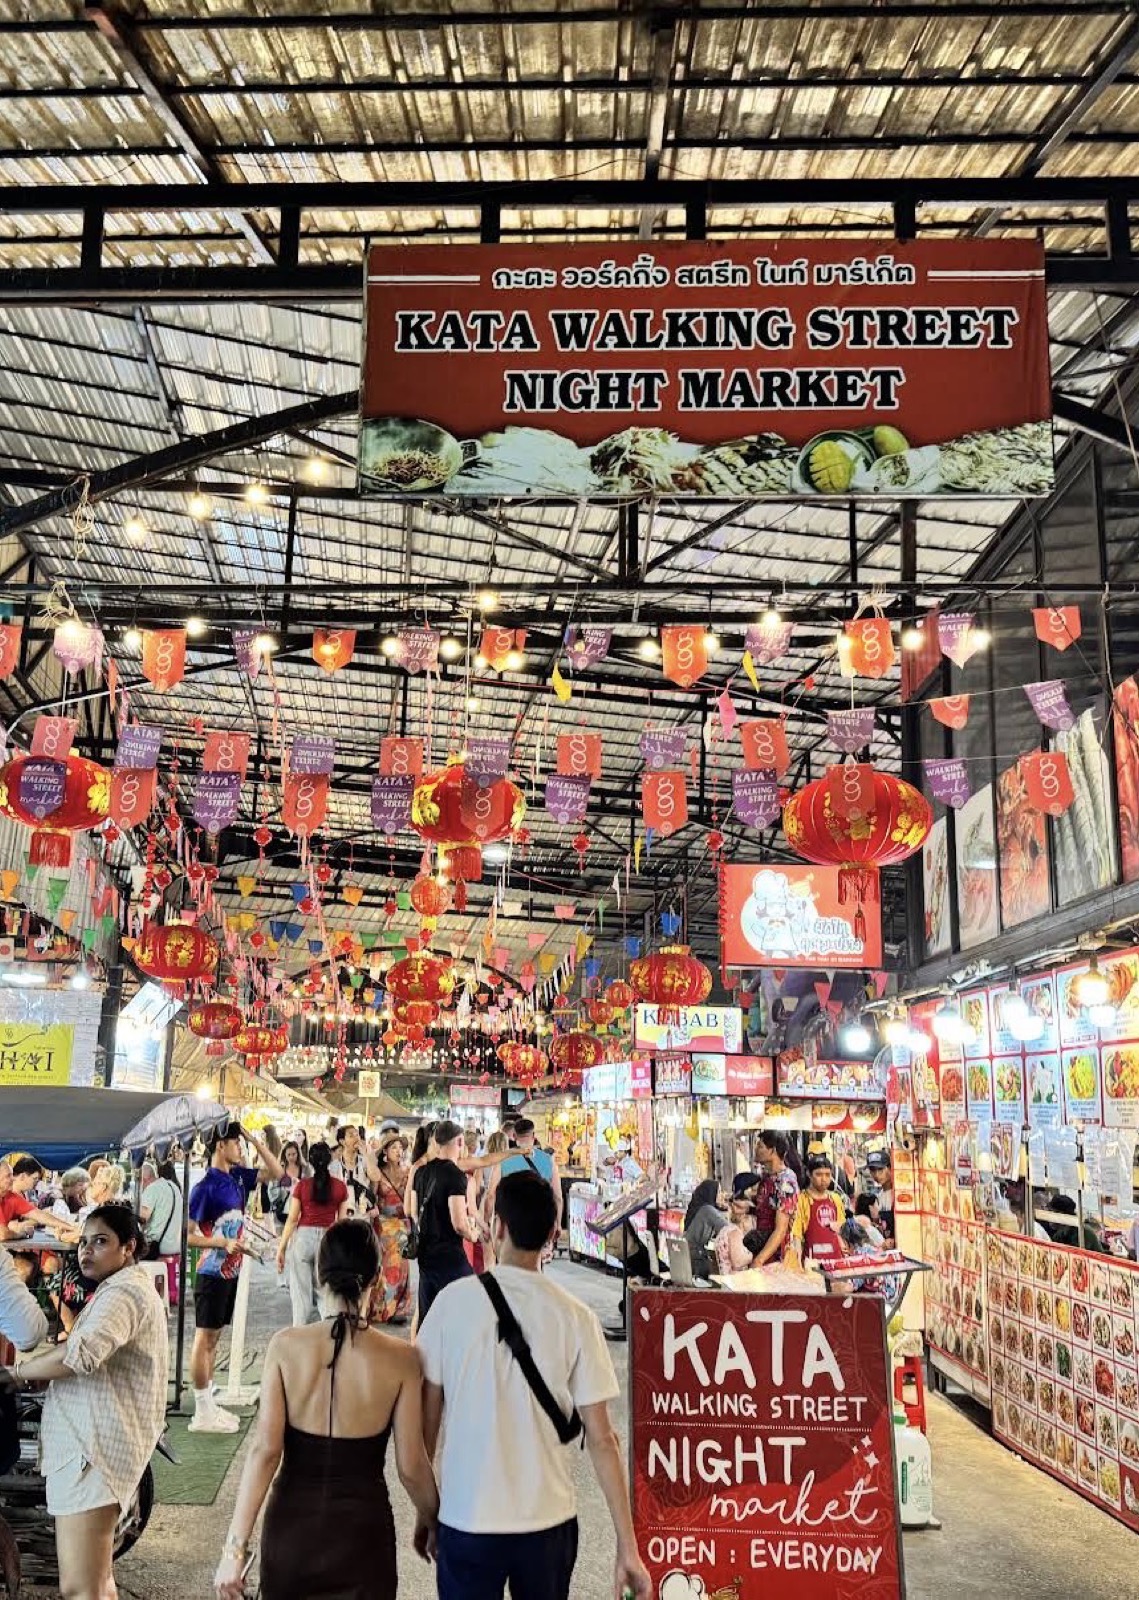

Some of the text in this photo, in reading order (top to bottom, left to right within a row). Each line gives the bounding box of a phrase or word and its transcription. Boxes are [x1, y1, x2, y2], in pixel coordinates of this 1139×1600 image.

[493, 253, 915, 288] กะตะ วอร์คกิ้ง สตรีท ไนท์ มาร์เก็ต
[394, 306, 1018, 353] KATA WALKING STREET
[503, 365, 906, 412] NIGHT MARKET
[21, 775, 60, 785] WALKING
[199, 776, 229, 786] KATA
[374, 777, 404, 786] KATA
[735, 772, 766, 783] KATA
[32, 784, 63, 793] STREET
[547, 779, 584, 791] WALKING
[196, 791, 233, 799] WALKING
[372, 791, 408, 800] WALKING
[734, 786, 773, 797] WALKING
[207, 799, 237, 807] STREET
[382, 799, 411, 808] STREET
[748, 794, 777, 804] STREET
[643, 1008, 719, 1028] KBAB
[662, 1309, 846, 1392] KATA
[651, 1391, 868, 1422] WALKING STREET
[647, 1435, 807, 1487] NIGHT
[708, 1469, 879, 1527] market
[647, 1535, 716, 1566] OPEN
[749, 1537, 883, 1574] EVERYDAY
